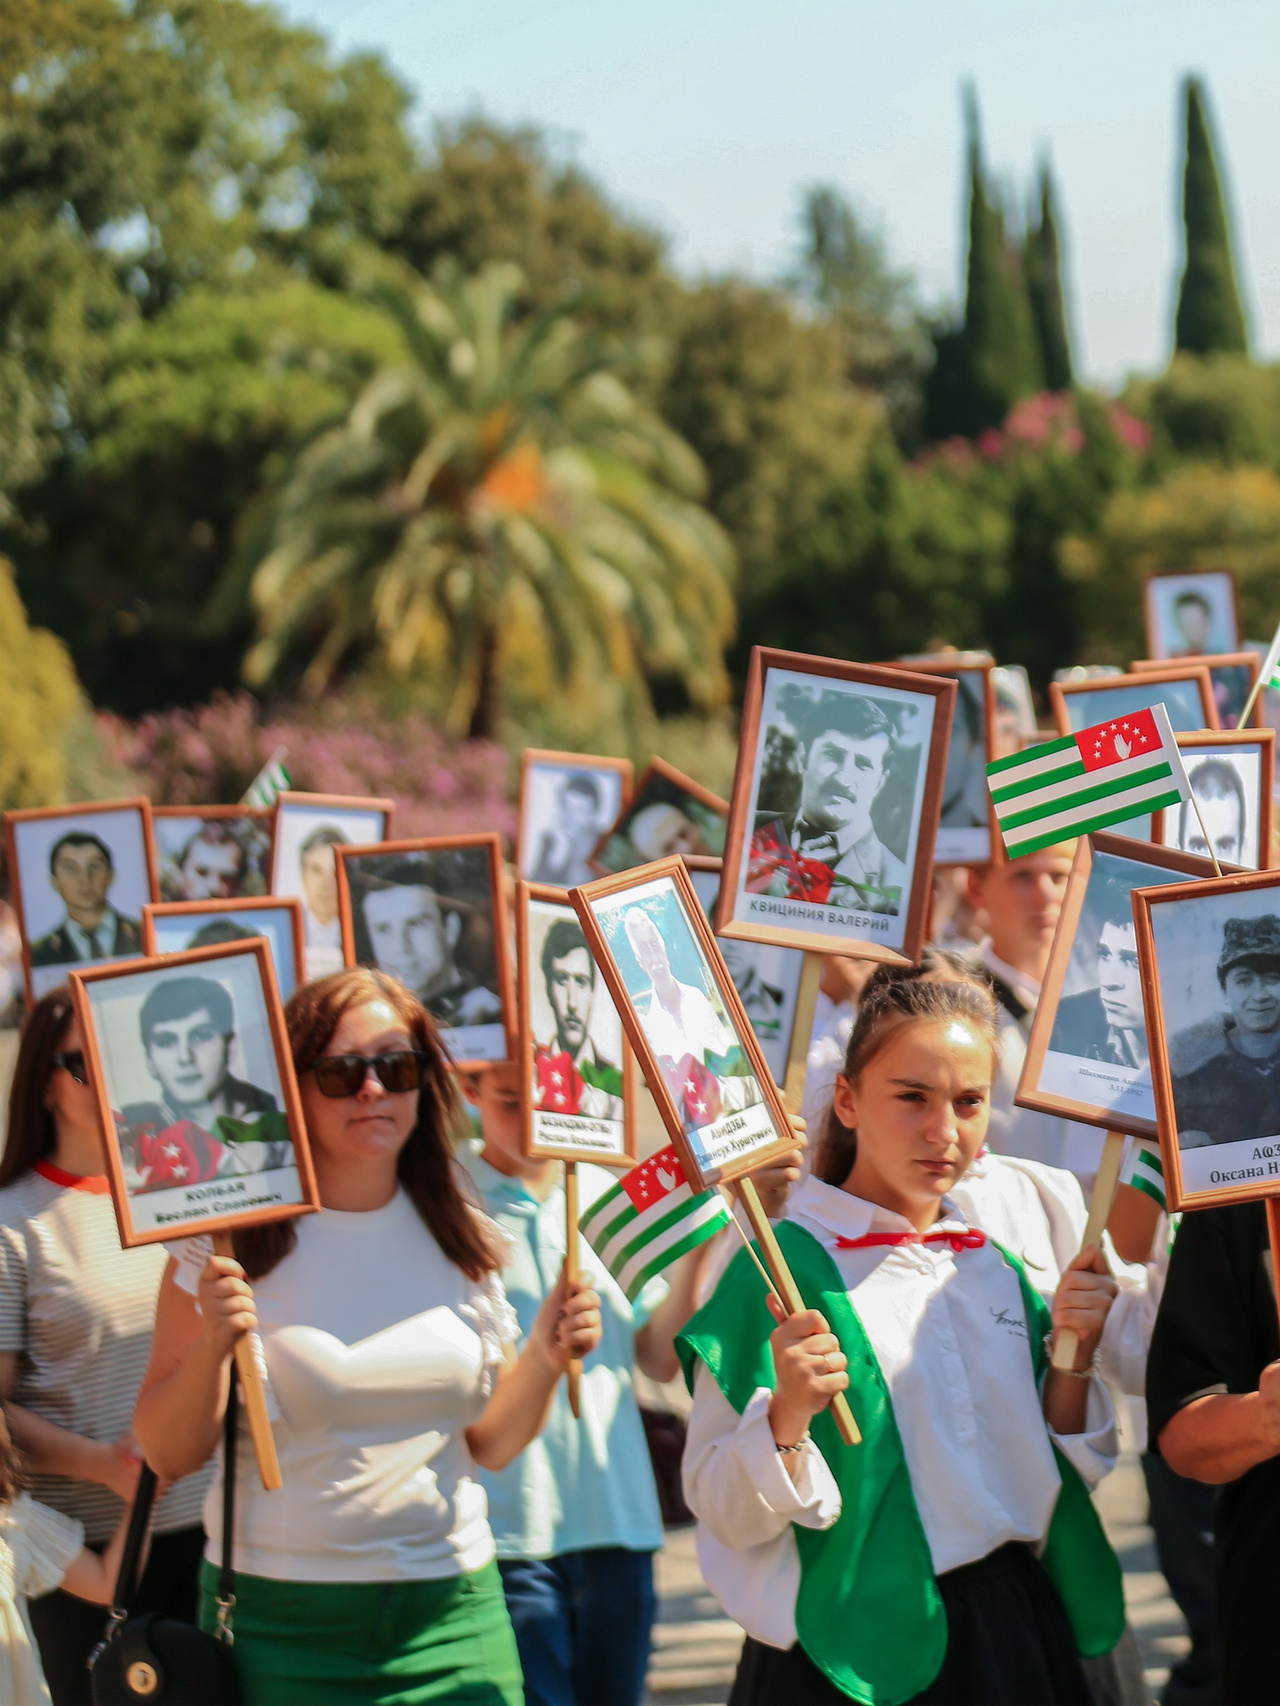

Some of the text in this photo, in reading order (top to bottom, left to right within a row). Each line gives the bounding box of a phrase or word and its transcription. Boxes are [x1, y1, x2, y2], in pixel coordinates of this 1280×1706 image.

[750, 900, 889, 931] КВИЦИНИЯ ВАЛЕРИЙ
[1210, 1165, 1264, 1184] Оксана
